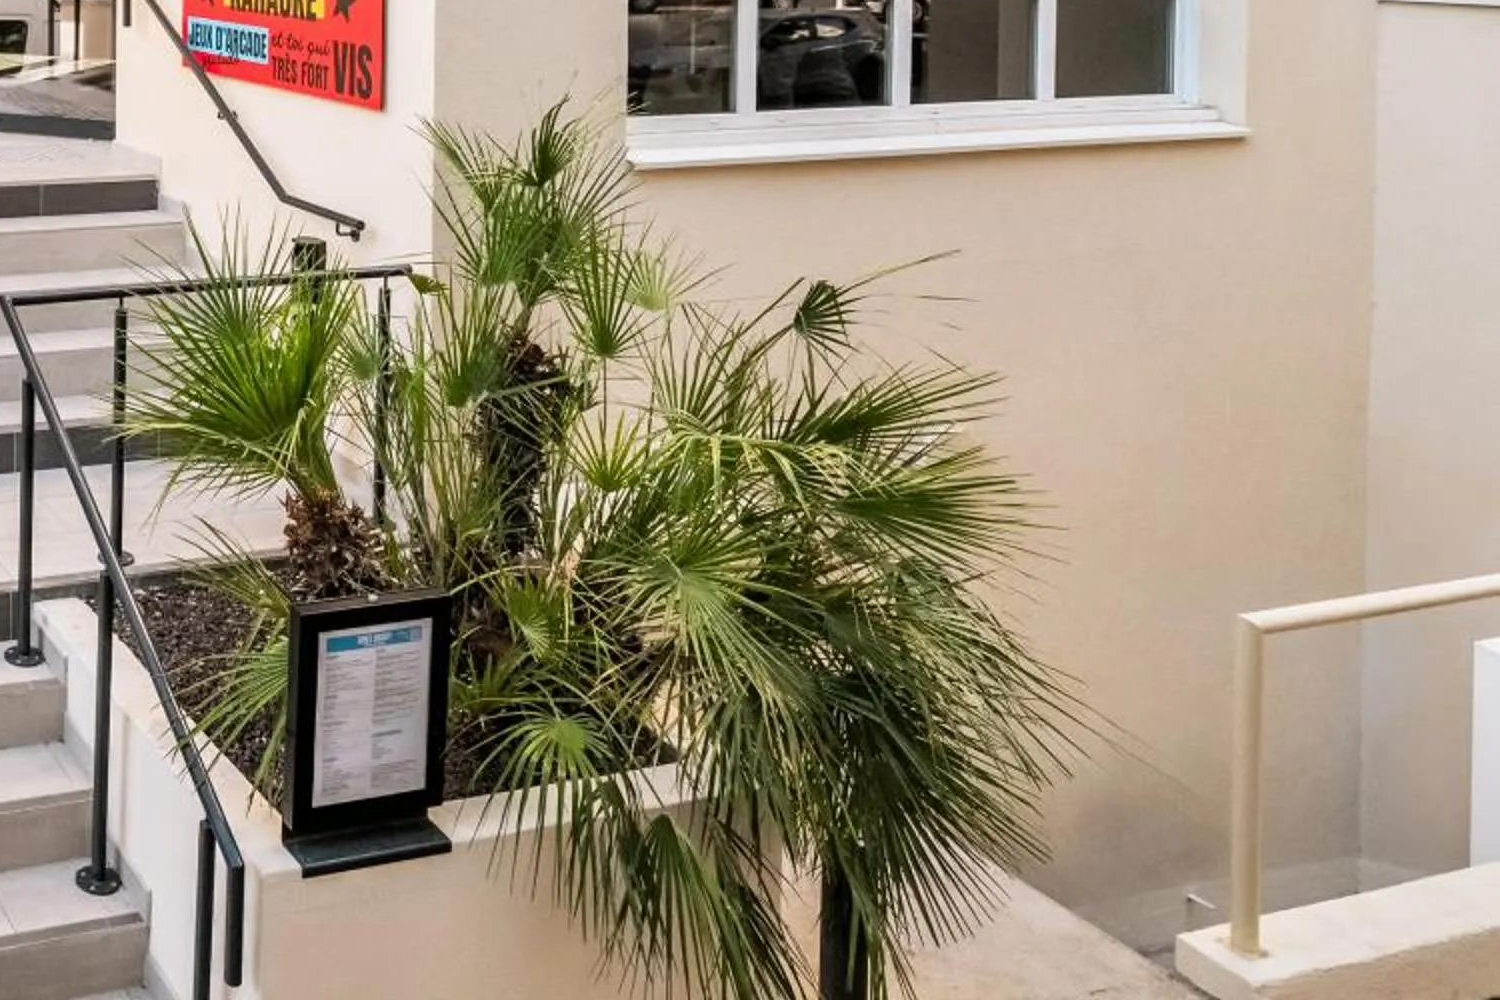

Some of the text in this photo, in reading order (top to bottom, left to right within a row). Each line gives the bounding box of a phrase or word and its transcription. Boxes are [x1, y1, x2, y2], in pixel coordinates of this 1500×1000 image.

[189, 23, 267, 58] JEUX D'ARCADE
[272, 52, 297, 85] TRÈS
[301, 61, 329, 91] FORT
[332, 40, 373, 99] VIS
